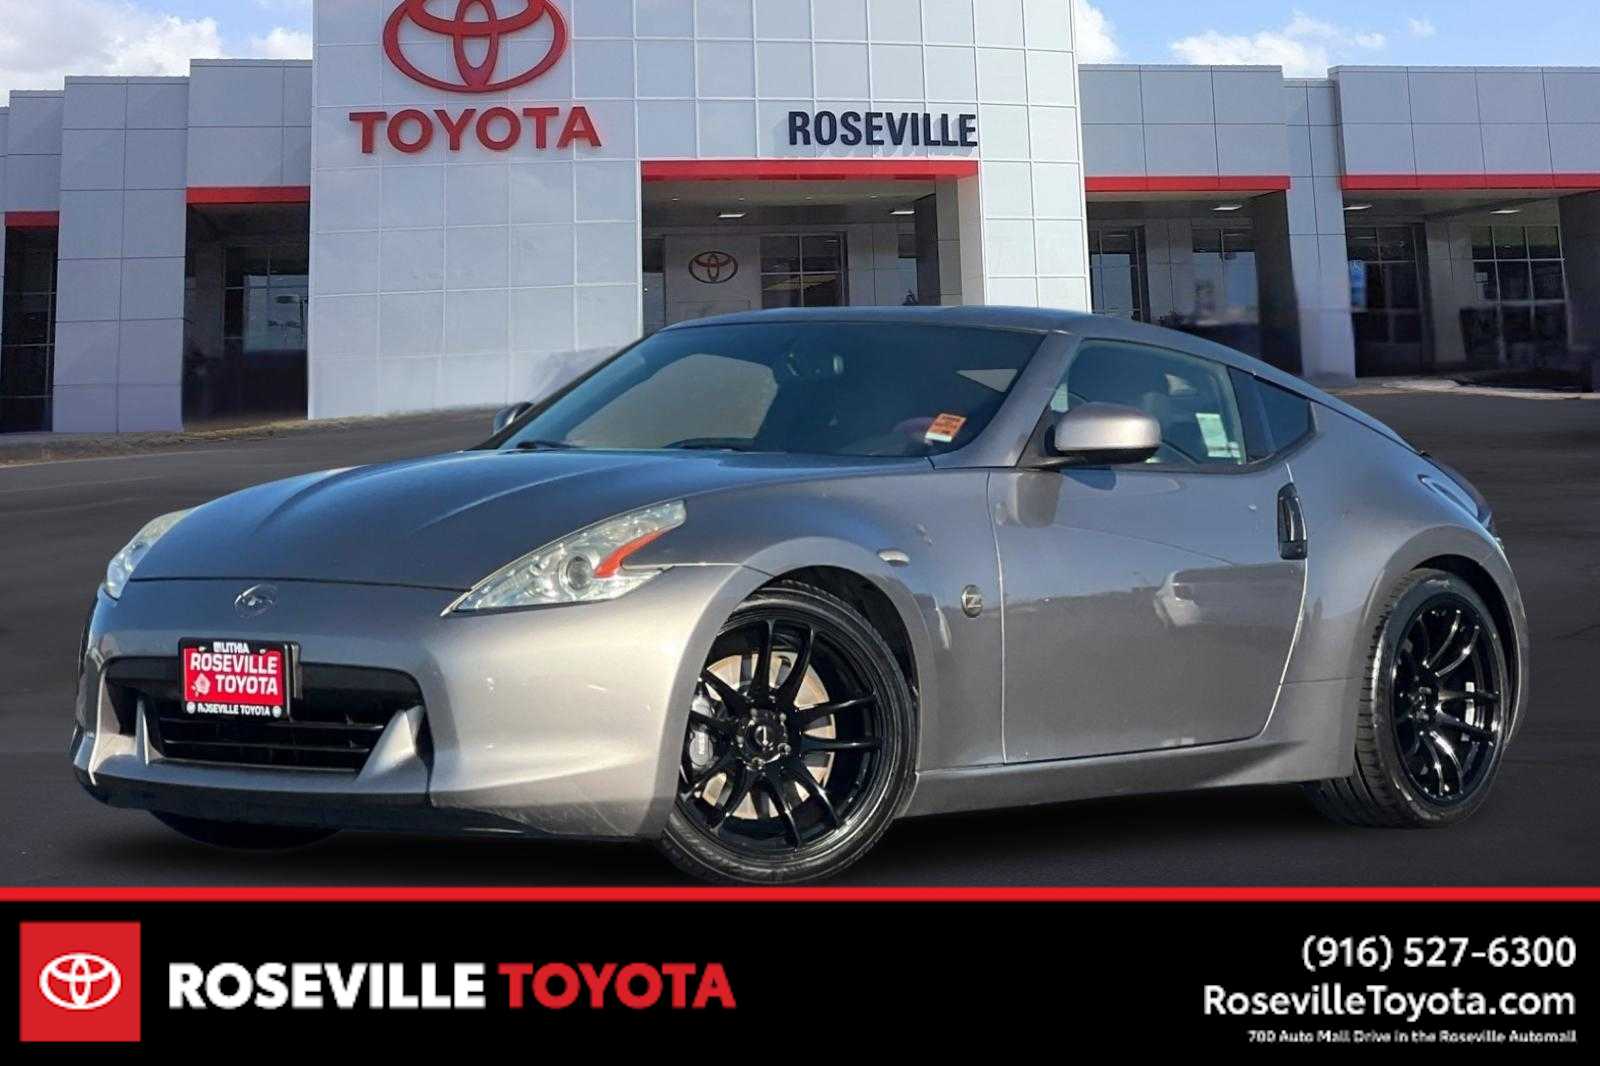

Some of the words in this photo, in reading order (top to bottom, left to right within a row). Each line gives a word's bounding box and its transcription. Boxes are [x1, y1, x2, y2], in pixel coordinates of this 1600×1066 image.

[350, 106, 602, 154] TOYOTA
[789, 111, 978, 147] ROSEVILLE
[190, 653, 278, 674] ROSEVILLE
[215, 674, 278, 696] TOYOTA
[197, 702, 240, 715] ROSEVILLE
[240, 704, 271, 716] TOYOTA
